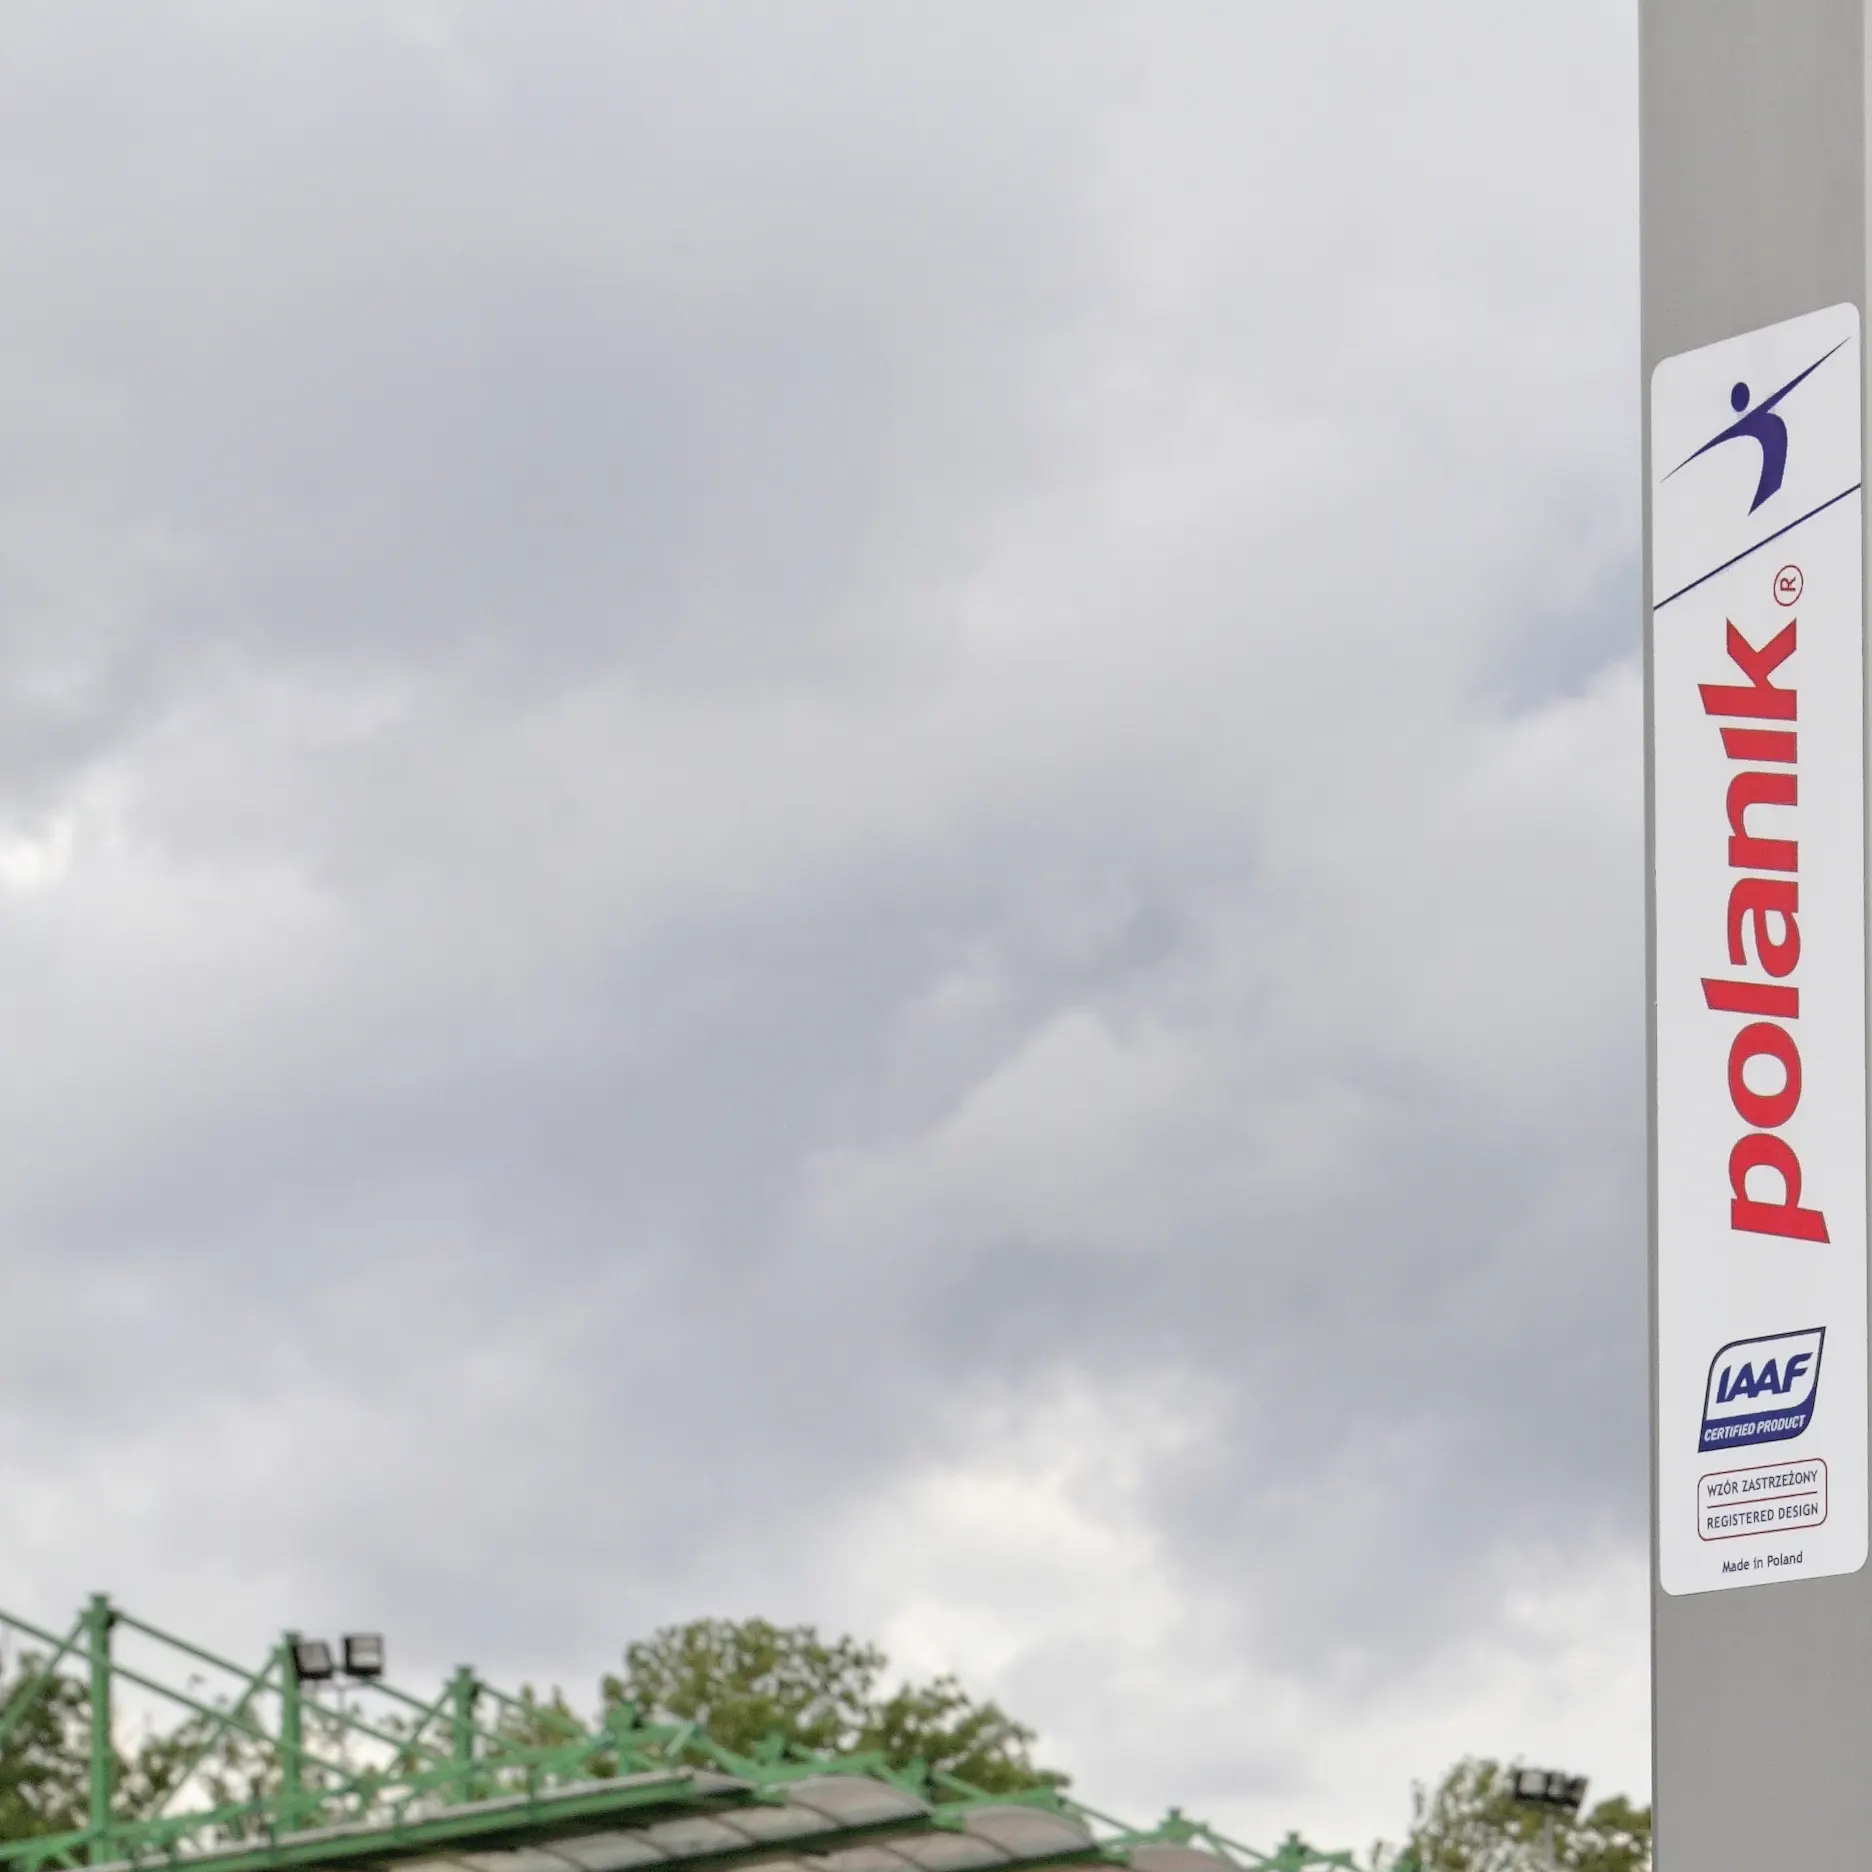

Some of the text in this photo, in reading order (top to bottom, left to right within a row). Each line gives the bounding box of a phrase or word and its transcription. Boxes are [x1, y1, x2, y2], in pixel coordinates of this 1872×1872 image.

[1715, 1352, 1813, 1404] IAAF
[1704, 1414, 1806, 1442] CERTIFIED PRODUCT
[1707, 1469, 1819, 1498] WZÓR ZASTRZEŻONY
[1707, 1502, 1819, 1530] REGISTERED DESIGN
[1721, 1550, 1803, 1573] Made in Poland
